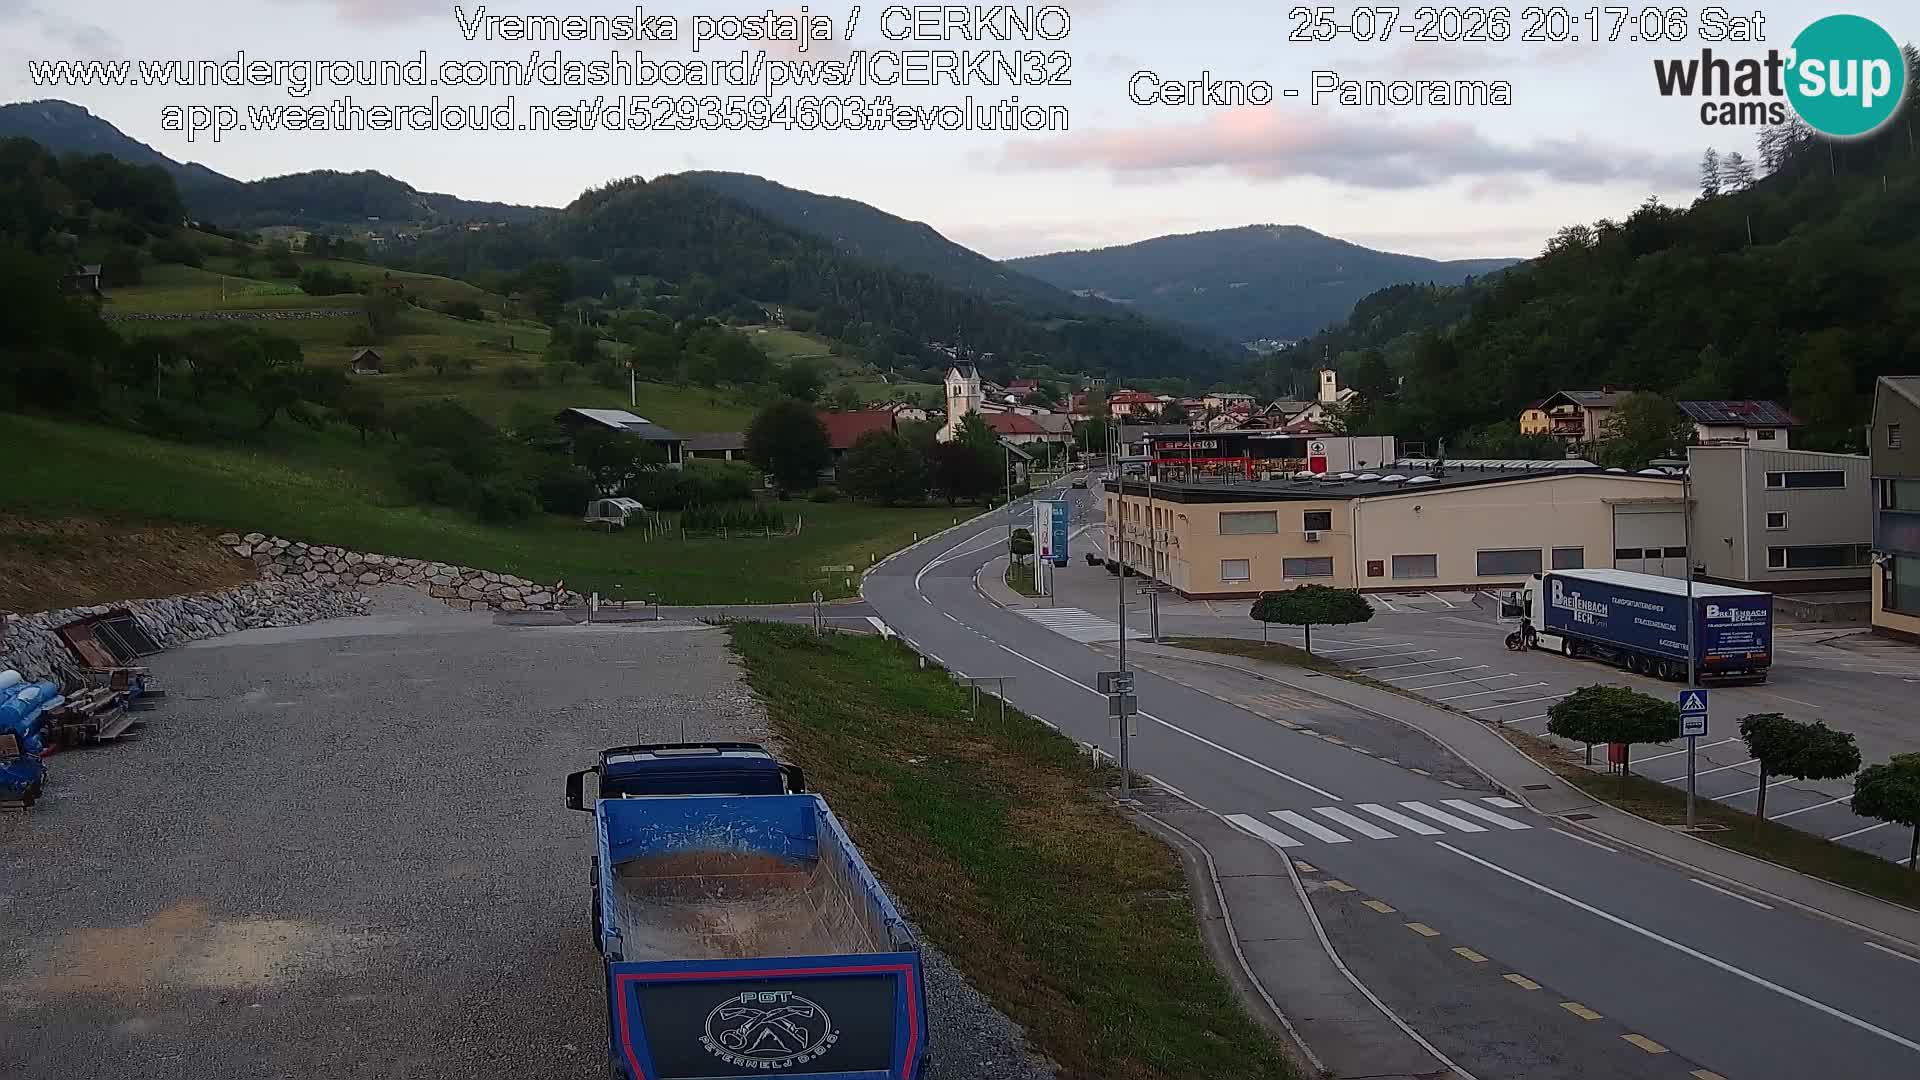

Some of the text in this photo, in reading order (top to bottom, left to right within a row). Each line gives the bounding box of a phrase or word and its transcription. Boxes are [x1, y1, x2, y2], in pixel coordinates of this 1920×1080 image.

[1165, 441, 1202, 449] SPAR
[740, 991, 793, 1004] PGT
[698, 1035, 793, 1069] PETERNELJ
